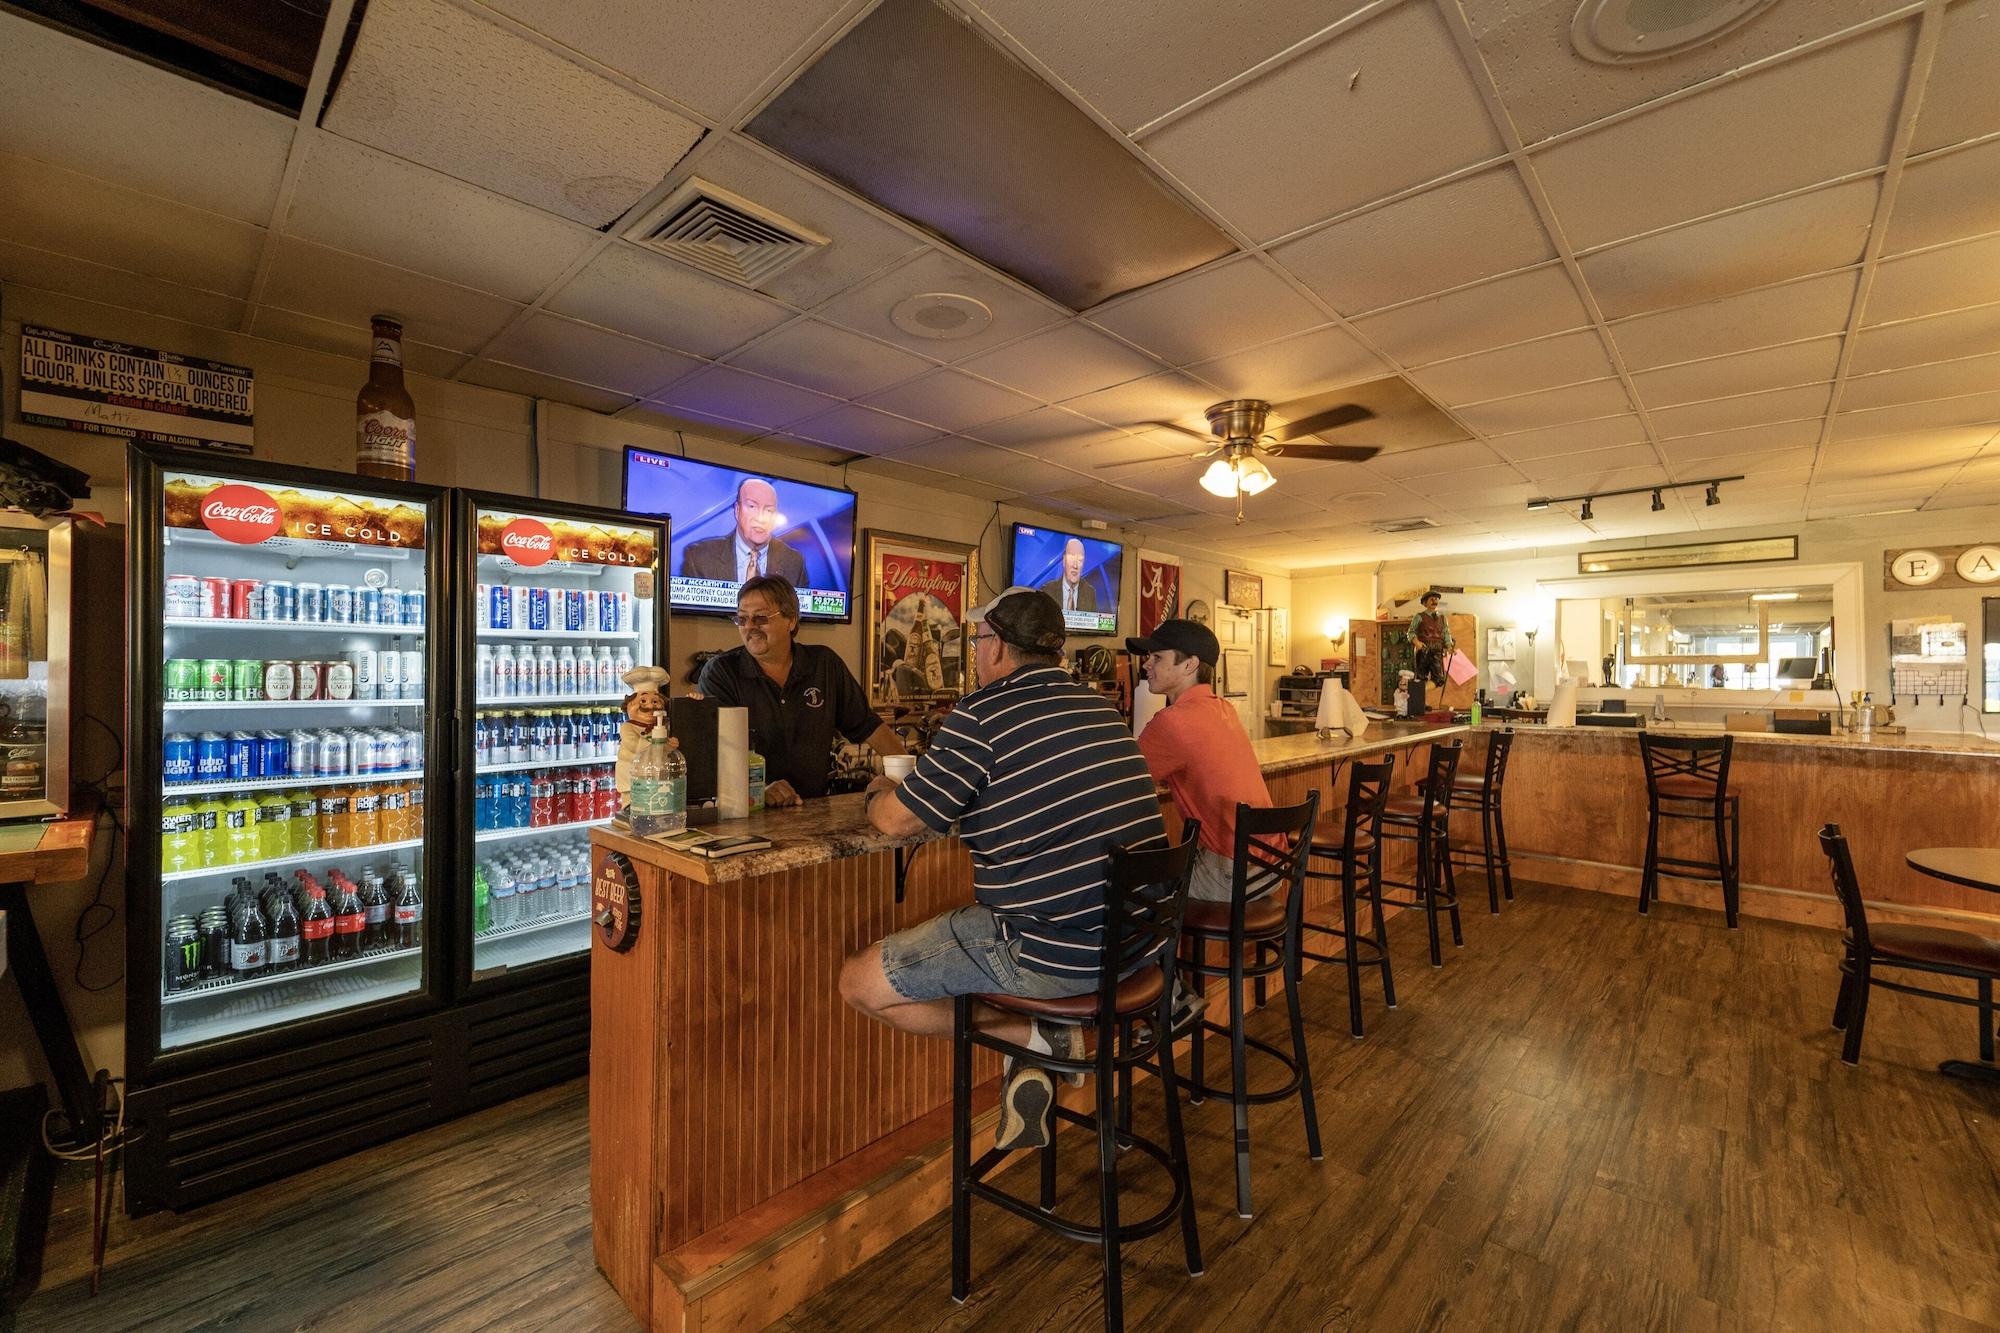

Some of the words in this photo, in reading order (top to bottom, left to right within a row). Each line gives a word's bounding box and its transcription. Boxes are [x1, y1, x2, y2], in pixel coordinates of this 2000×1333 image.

[24, 338, 50, 359] ALL
[55, 343, 105, 369] DRINKS
[109, 354, 165, 380] CONTAIN
[24, 357, 79, 384] LIQUOR,
[83, 367, 135, 392] UNLESS
[138, 378, 190, 402] SPECIAL
[193, 387, 251, 413] ORDERED.
[188, 369, 235, 392] OUNCES
[237, 379, 252, 395] OF
[83, 423, 100, 433] FOR
[101, 426, 136, 438] TOBACCO
[153, 433, 167, 442] FOR
[168, 435, 201, 447] ALCOHOL
[365, 419, 408, 440] Coors
[365, 434, 406, 448] LIGHT
[640, 456, 666, 467] LIVE
[203, 501, 274, 525] Coca-Cola
[296, 522, 332, 536] ICE
[345, 526, 401, 542] COLD
[503, 532, 553, 551] Coca-Cola
[564, 547, 589, 559] ICE
[597, 550, 637, 563] COLD
[1906, 559, 1929, 578] E
[688, 580, 725, 588] MCCARTHY
[883, 561, 961, 598] Yuengling
[1142, 566, 1164, 601] A
[671, 585, 686, 593] UMP
[687, 587, 716, 597] ATTORNEY
[716, 590, 737, 598] CLAIMS
[671, 593, 690, 601] IMING
[691, 595, 710, 603] VOTER
[710, 597, 729, 605] FRAUD
[536, 600, 544, 625] ULTRA
[164, 767, 194, 775] LIGHT
[197, 764, 227, 773] LIGHT
[199, 758, 224, 766] BUD
[162, 814, 192, 824] OWER
[595, 877, 611, 900] BEST
[610, 881, 625, 906] BEER
